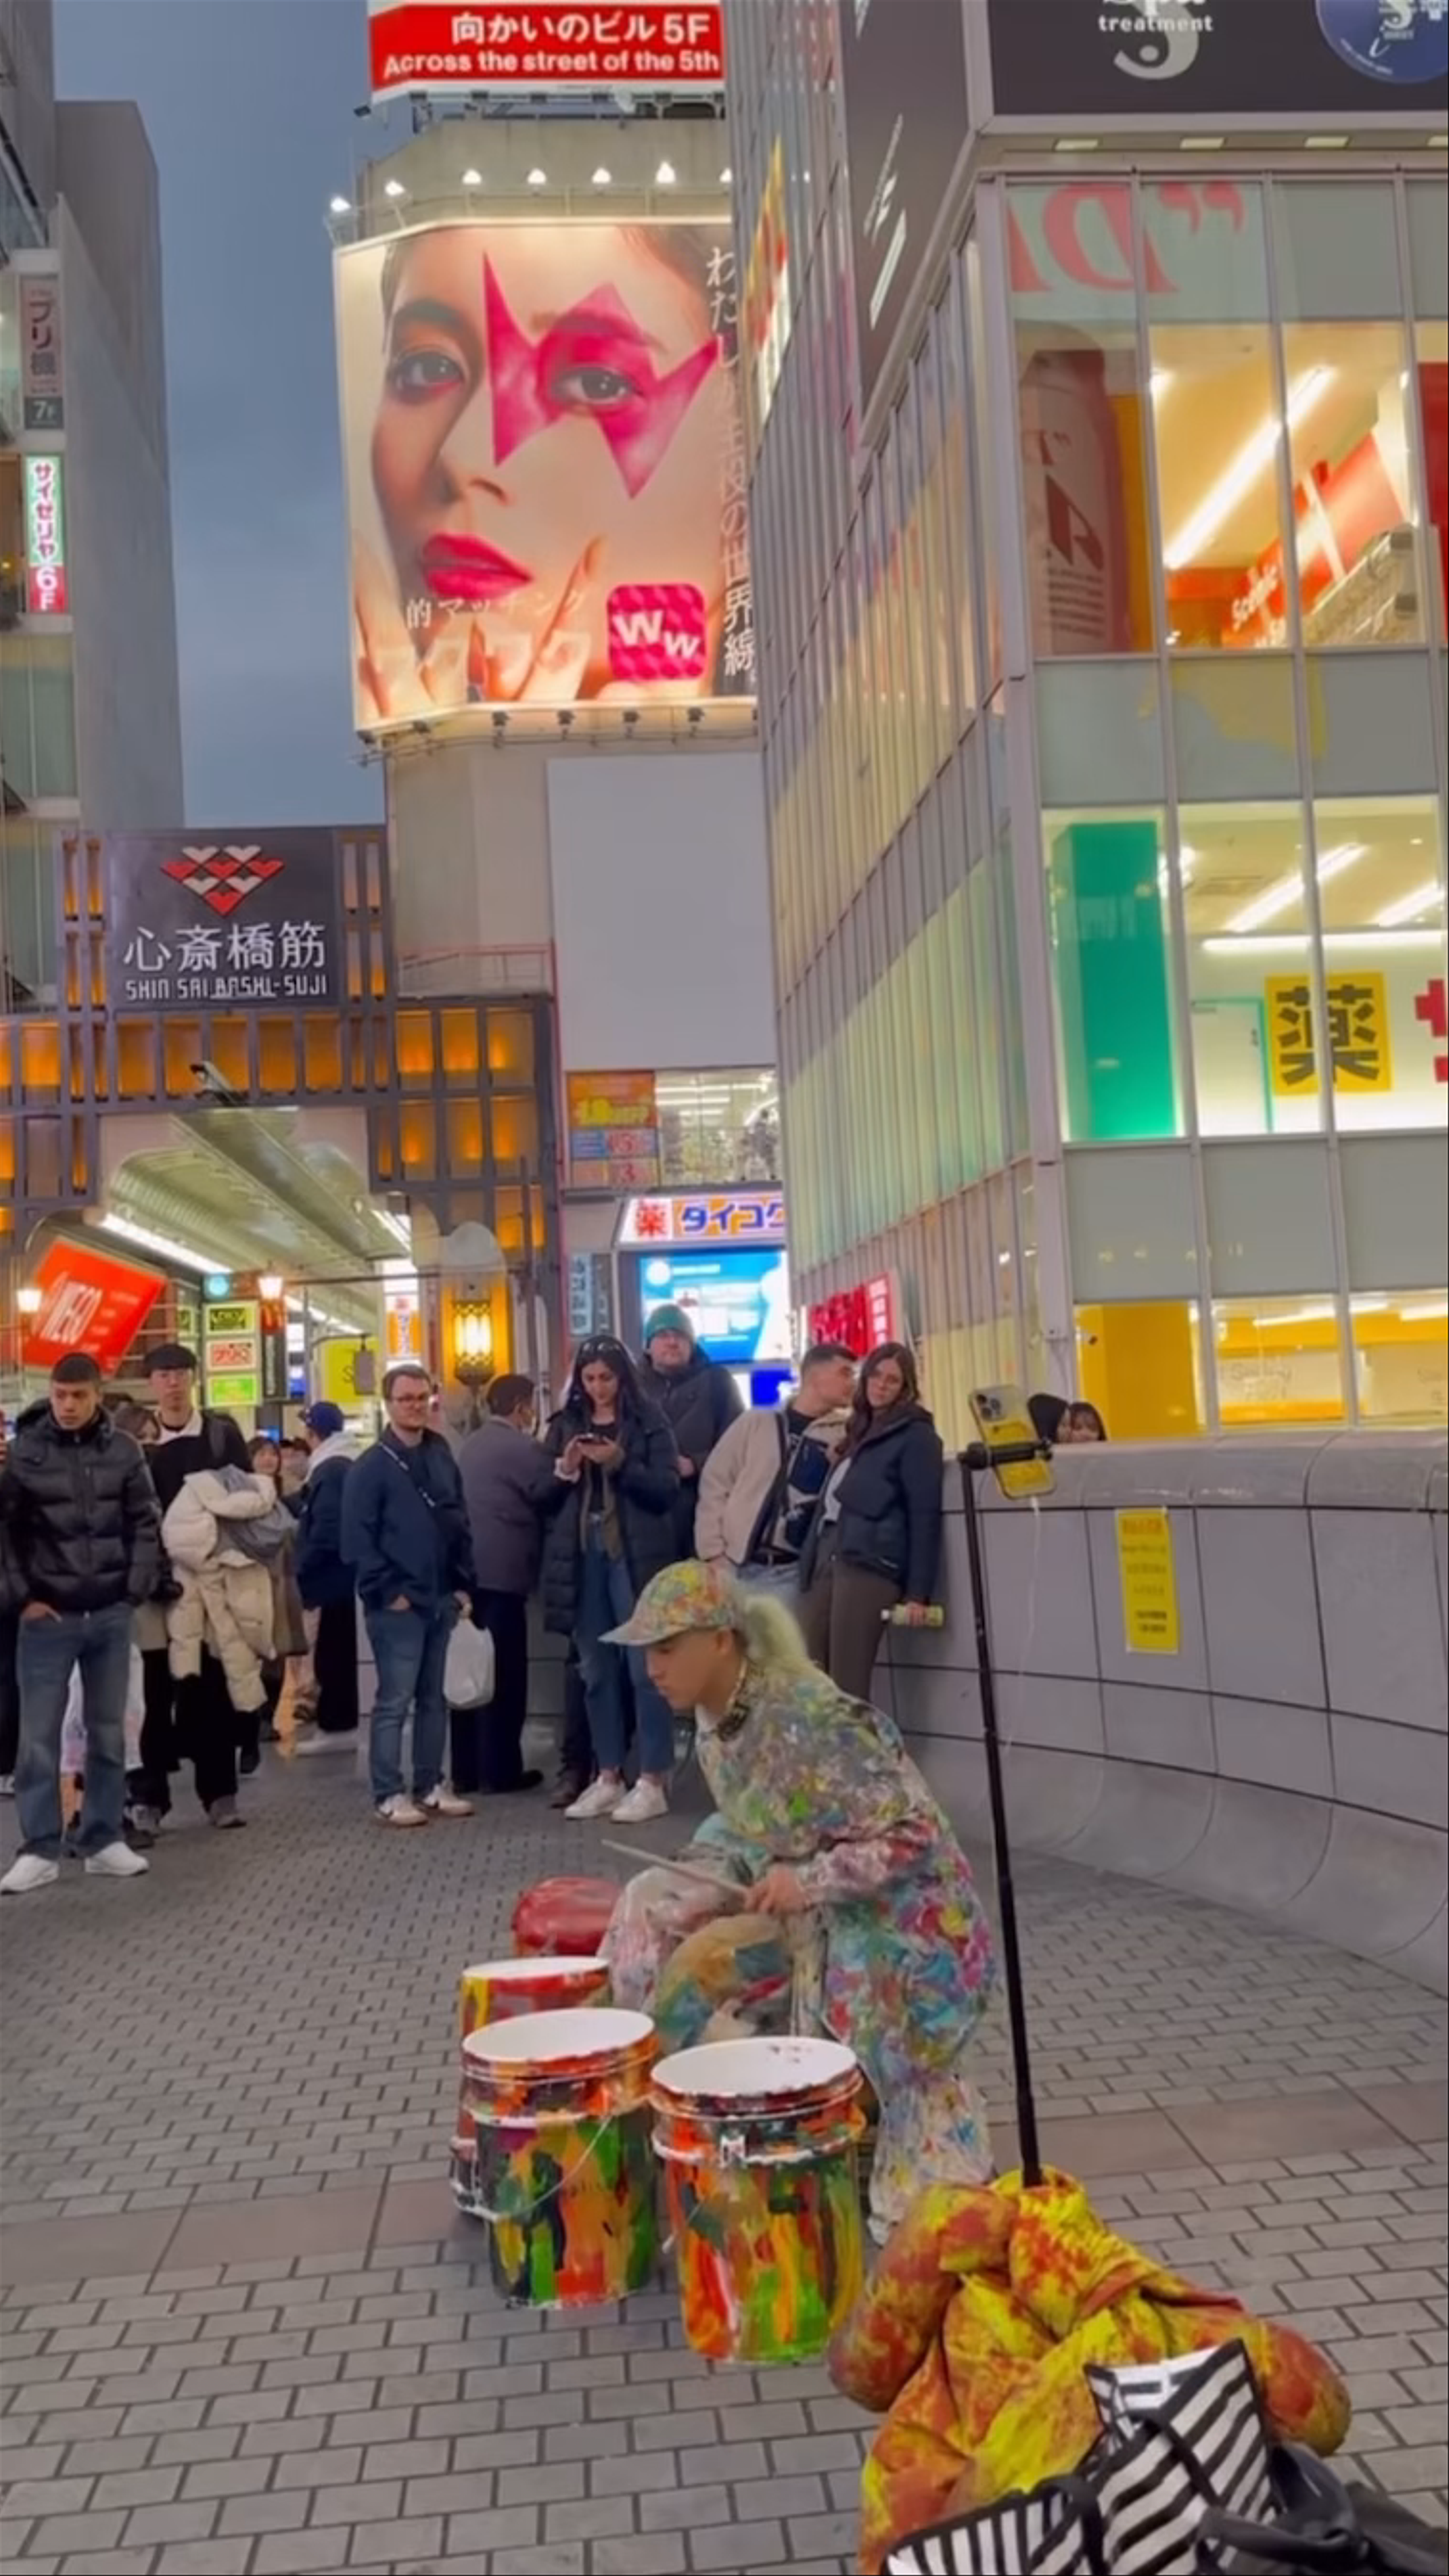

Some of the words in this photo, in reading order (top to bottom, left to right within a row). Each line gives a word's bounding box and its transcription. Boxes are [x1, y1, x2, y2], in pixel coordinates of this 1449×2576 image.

[1098, 15, 1214, 32] treatment
[384, 52, 471, 78] Across
[477, 50, 517, 71] the
[522, 50, 598, 71] street
[603, 49, 629, 71] of
[634, 49, 675, 71] the
[679, 49, 719, 71] 5th
[33, 401, 55, 420] 7F
[36, 567, 57, 612] 6F
[123, 920, 326, 972] 心斎橋筋
[126, 980, 169, 1001] SHIN
[1275, 984, 1380, 1086] 薬
